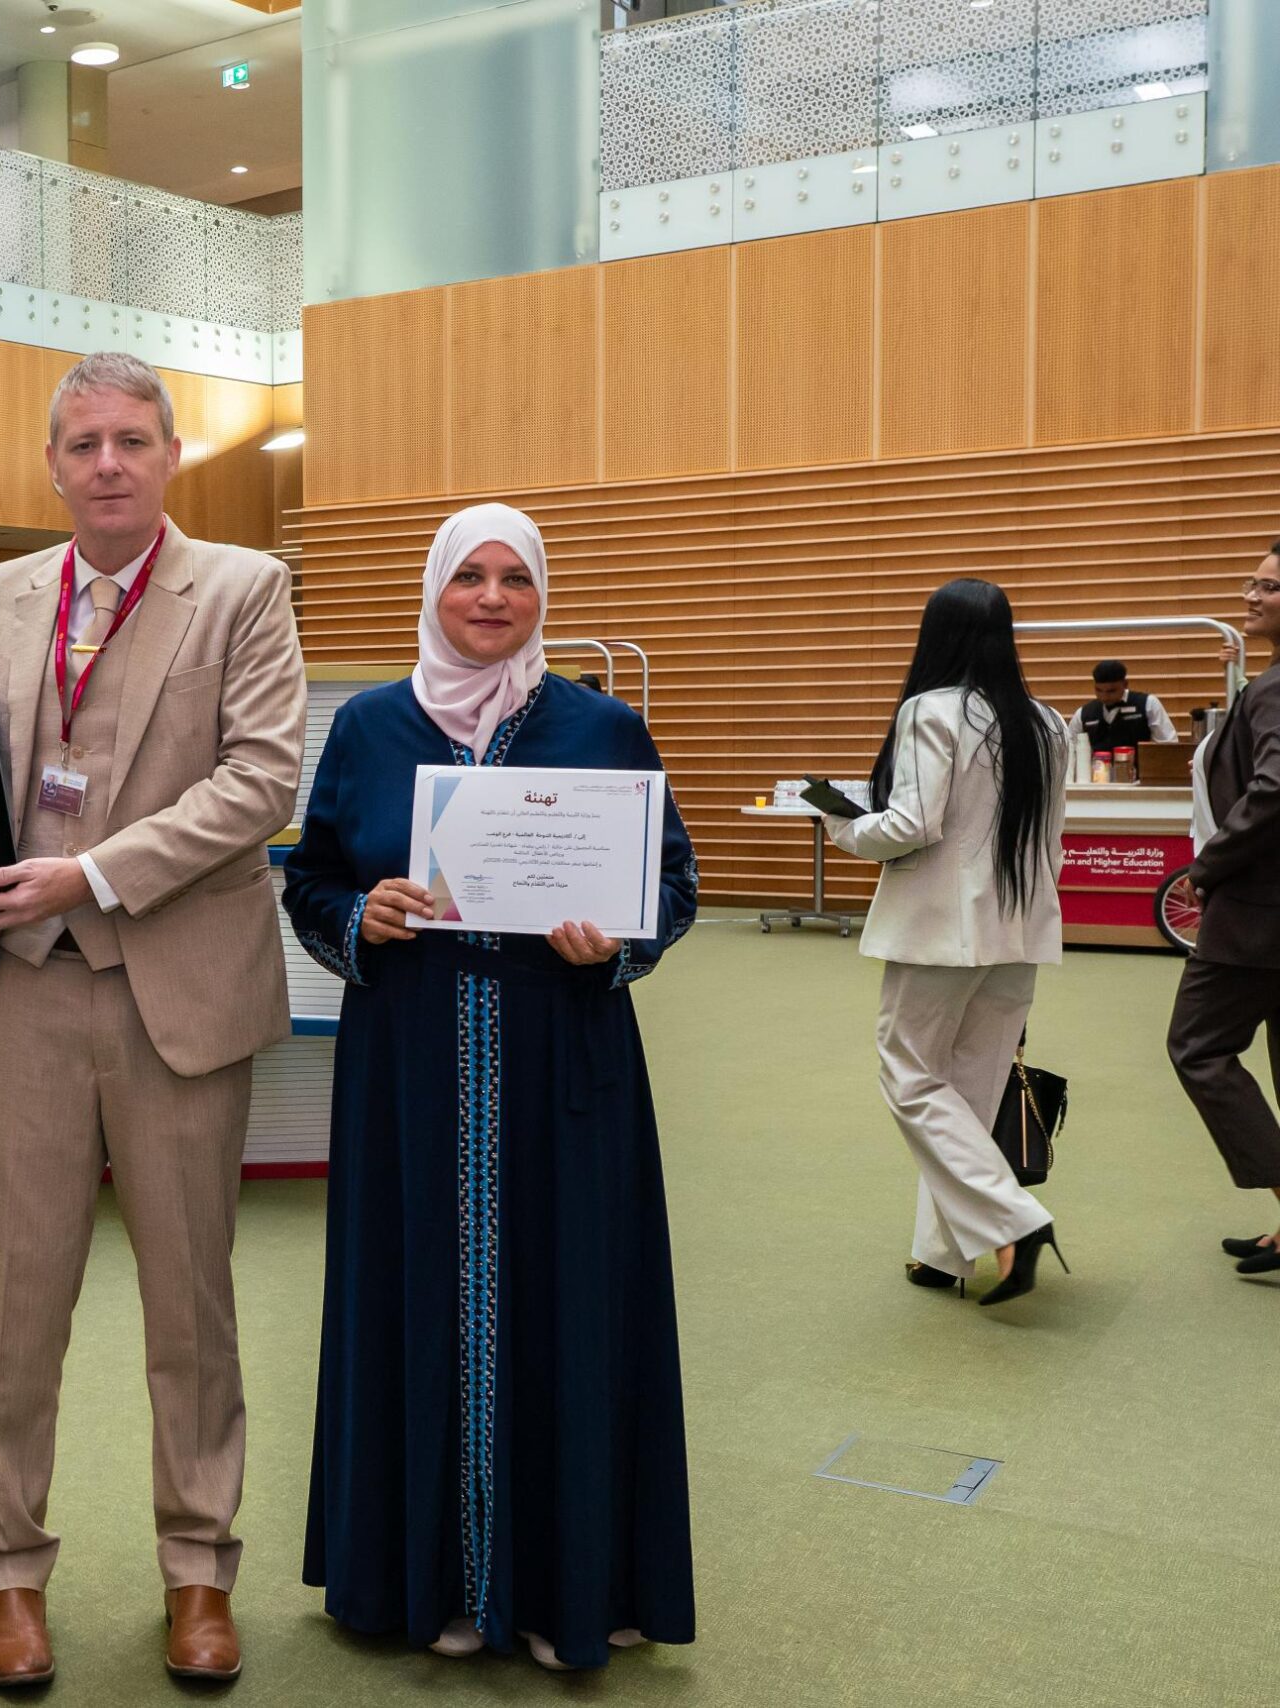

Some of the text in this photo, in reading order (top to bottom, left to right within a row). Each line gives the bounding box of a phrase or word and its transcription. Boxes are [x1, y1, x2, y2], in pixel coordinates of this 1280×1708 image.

[524, 790, 558, 807] تهنئة
[1146, 848, 1164, 857] وزارة
[1077, 858, 1092, 866] and
[1093, 858, 1121, 868] Higher
[1123, 858, 1164, 867] Education
